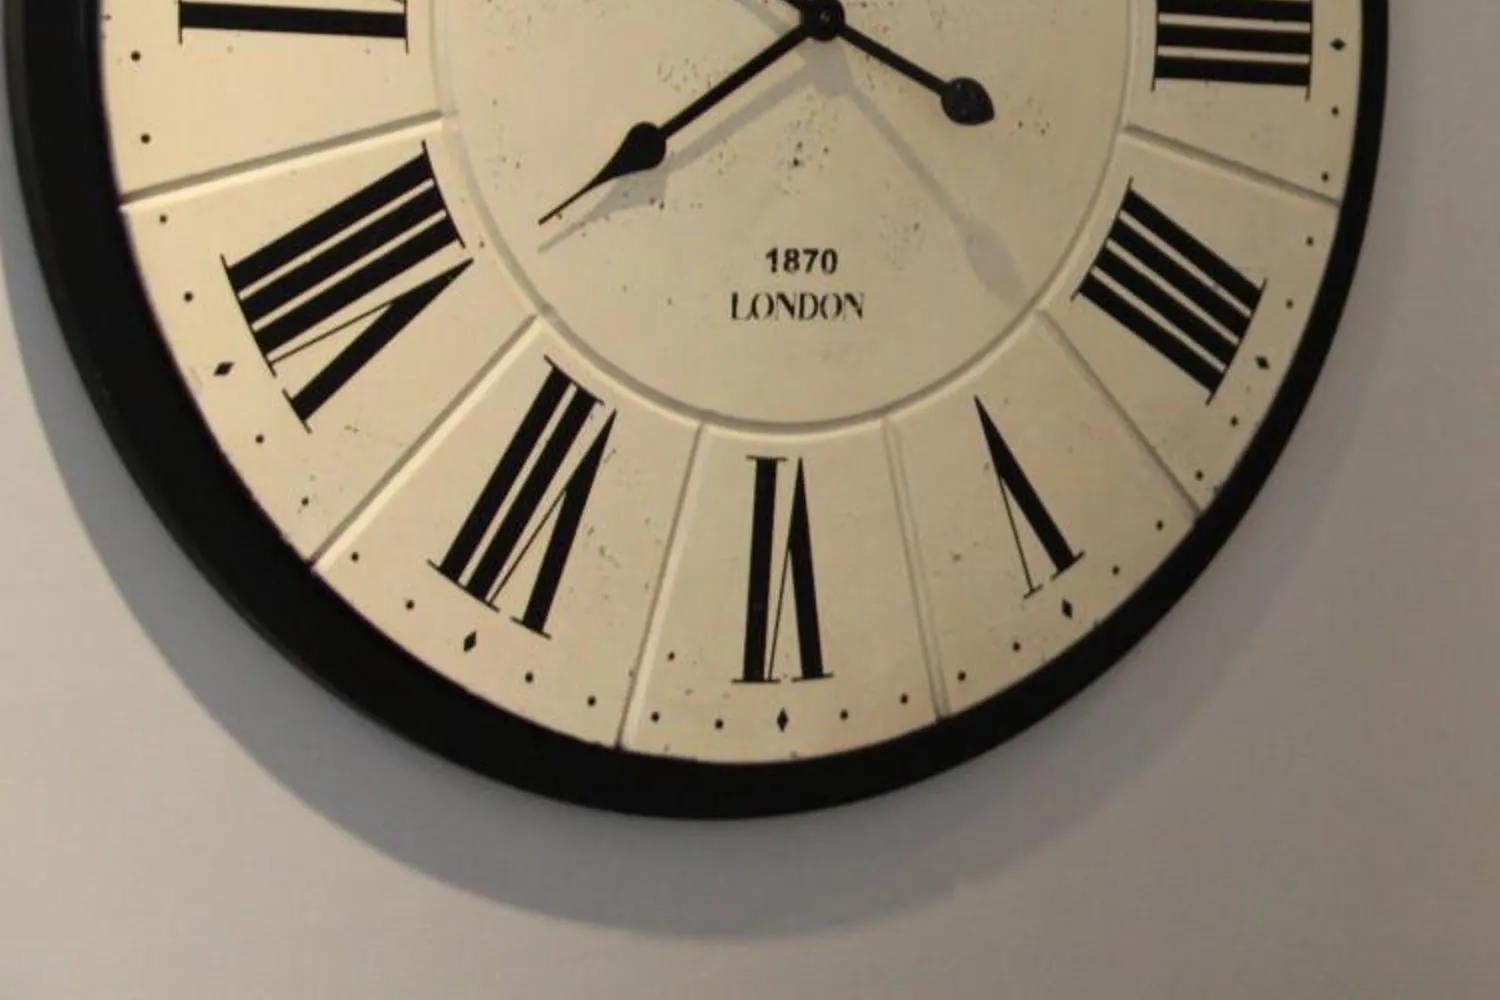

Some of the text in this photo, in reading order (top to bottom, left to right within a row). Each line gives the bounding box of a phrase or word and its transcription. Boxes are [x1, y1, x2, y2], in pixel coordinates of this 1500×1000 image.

[219, 140, 474, 433] VIII
[730, 291, 866, 321] LONDON
[765, 247, 839, 275] 1870
[1071, 176, 1268, 406] IIII
[427, 356, 618, 639] VII
[731, 456, 834, 684] VI
[974, 395, 1085, 599] V
